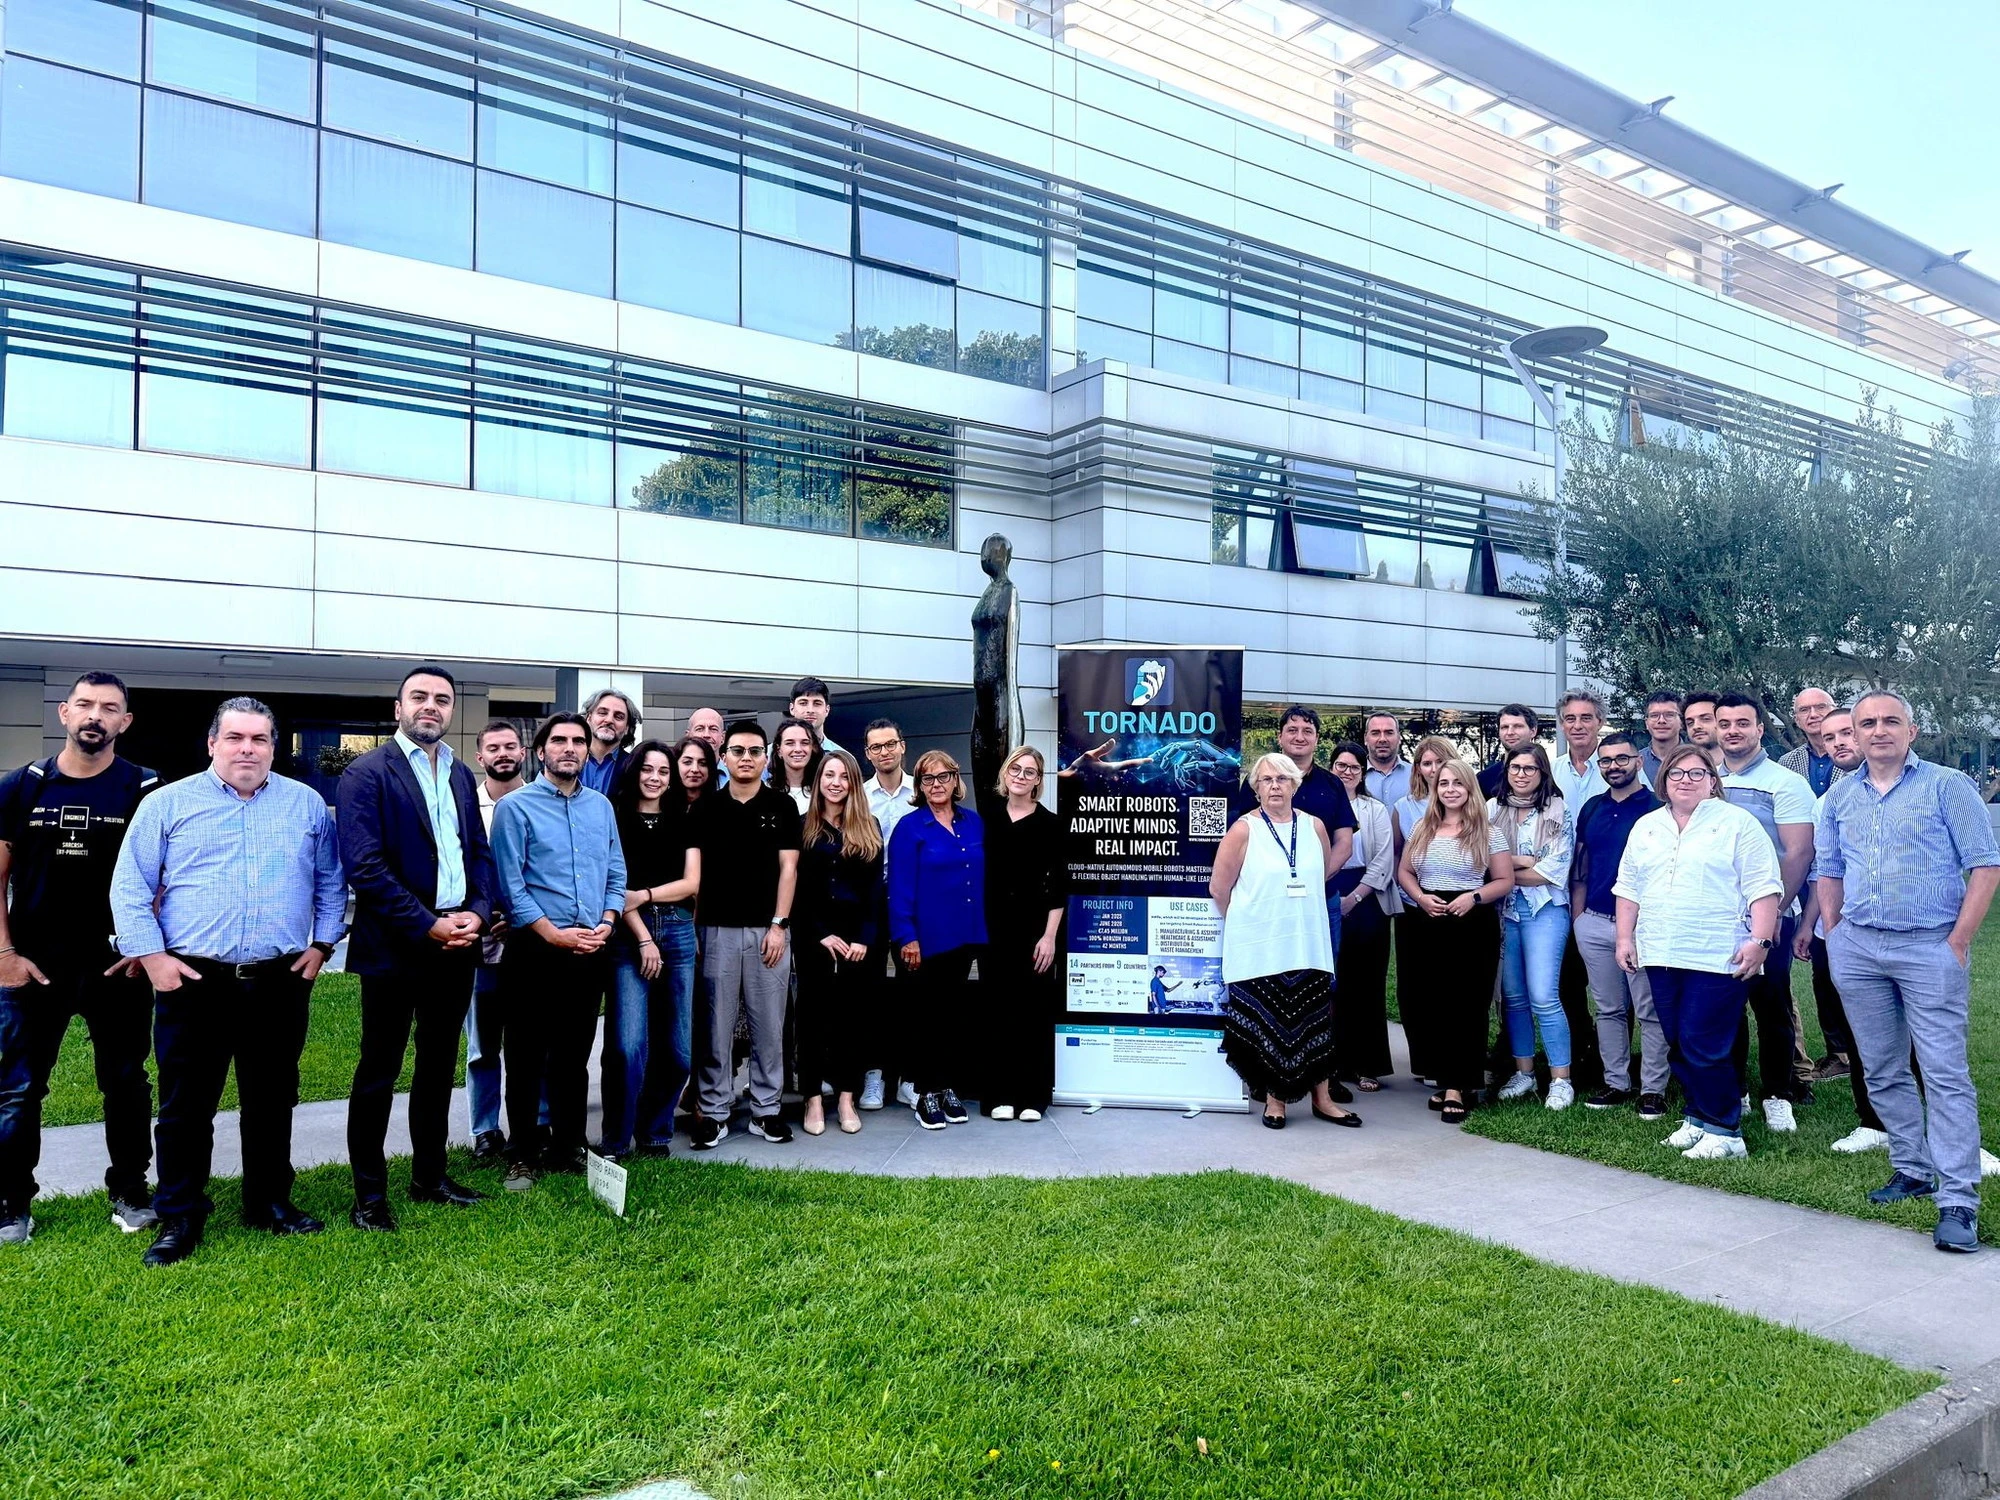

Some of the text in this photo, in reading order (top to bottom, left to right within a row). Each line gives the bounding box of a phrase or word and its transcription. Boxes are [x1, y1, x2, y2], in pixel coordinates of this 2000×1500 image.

[1083, 711, 1216, 734] TORNADO
[1078, 796, 1180, 812] SMART ROBOTS.
[104, 816, 125, 824] SOLUTION
[1070, 817, 1180, 834] ADAPTIVE MINDS.
[1095, 840, 1180, 856] REAL IMPACT.
[1067, 863, 1105, 871] CLOUD-NATIVE
[1106, 863, 1142, 872] AUTONOMOUS
[1143, 864, 1163, 872] MOBILE
[1186, 865, 1212, 873] MASTERIN
[1121, 873, 1147, 881] HANDLING
[1164, 874, 1196, 882] HUMAN-LIKE
[1083, 900, 1134, 910] PROJECT INFO
[1169, 902, 1209, 912] USE CASES
[1070, 959, 1079, 968] 14
[1116, 960, 1122, 969] 9
